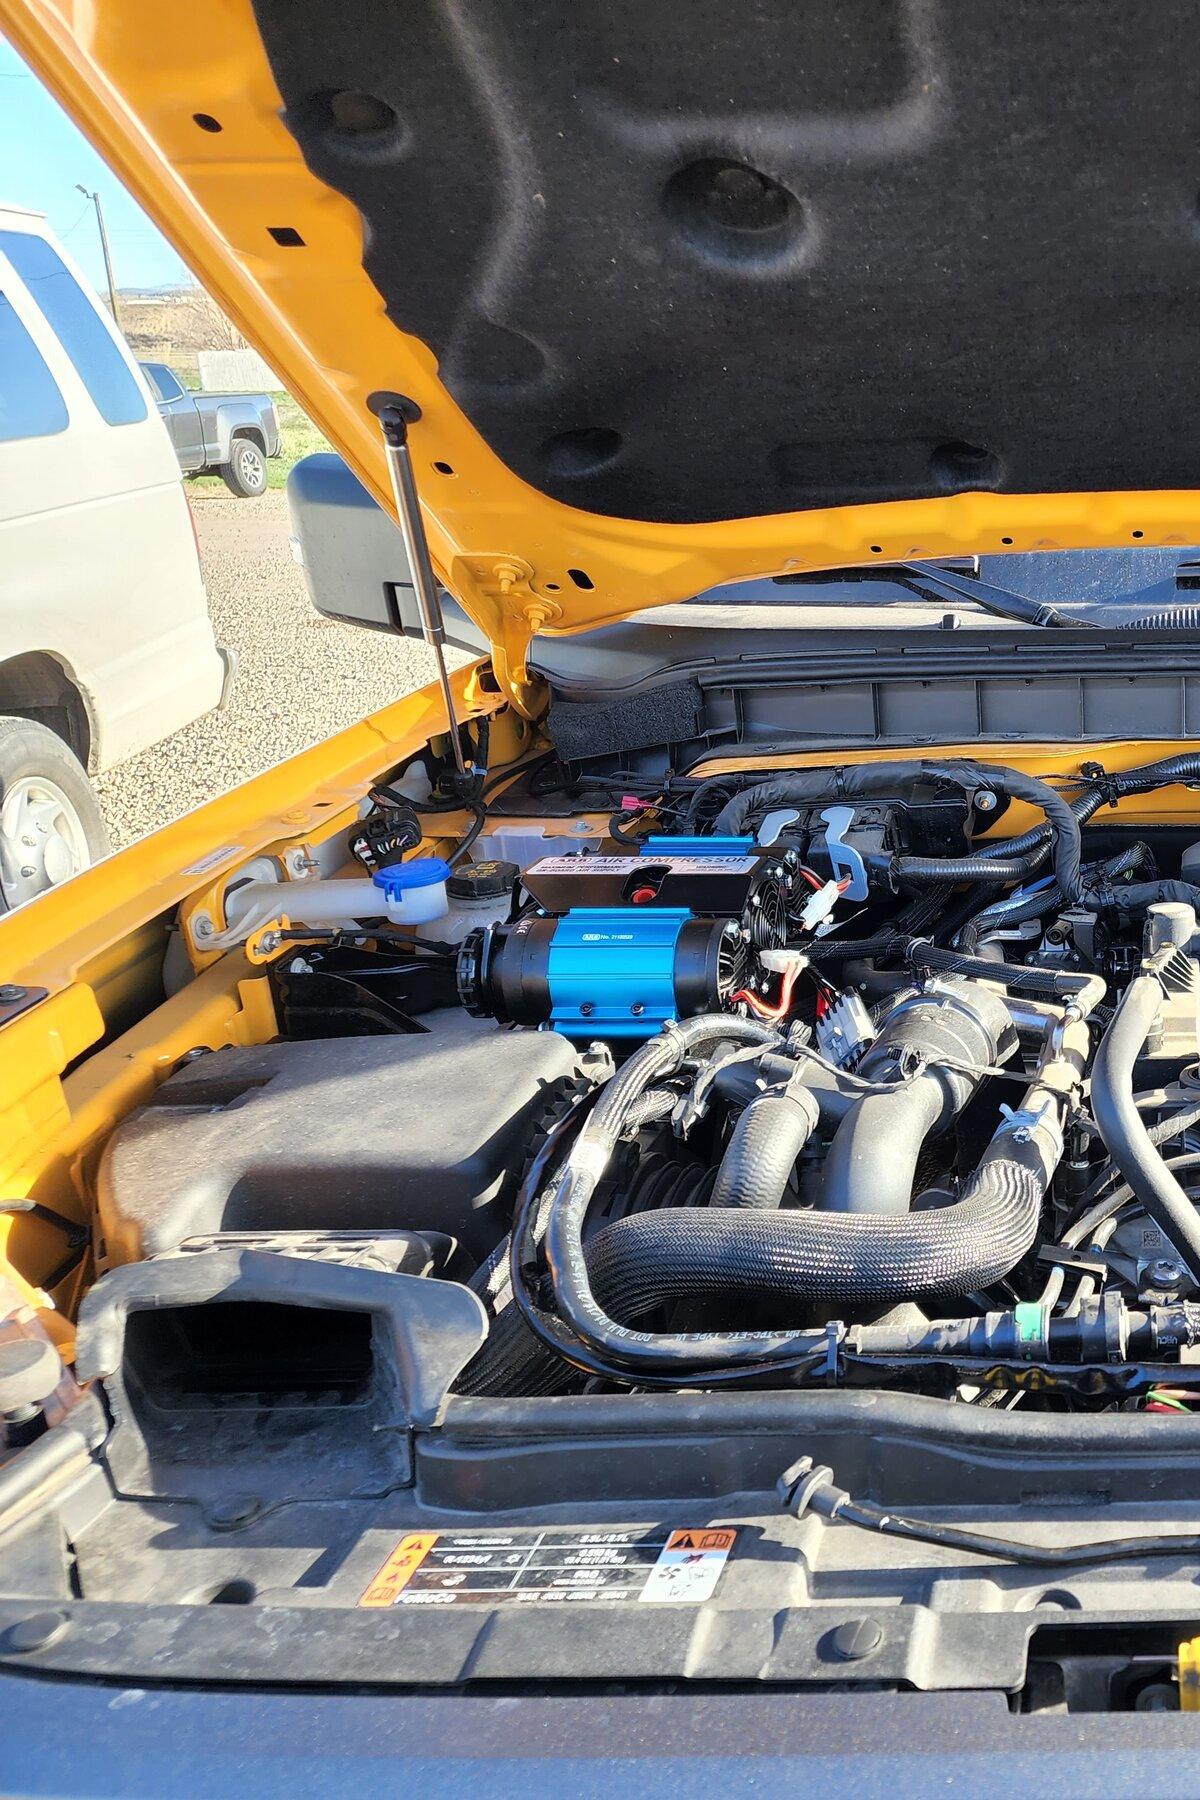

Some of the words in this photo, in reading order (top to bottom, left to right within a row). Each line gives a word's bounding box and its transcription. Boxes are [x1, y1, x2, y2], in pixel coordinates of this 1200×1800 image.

[629, 1333, 652, 1342] DOT
[691, 1332, 720, 1341] TYPE
[393, 1592, 458, 1604] FoMoCo
